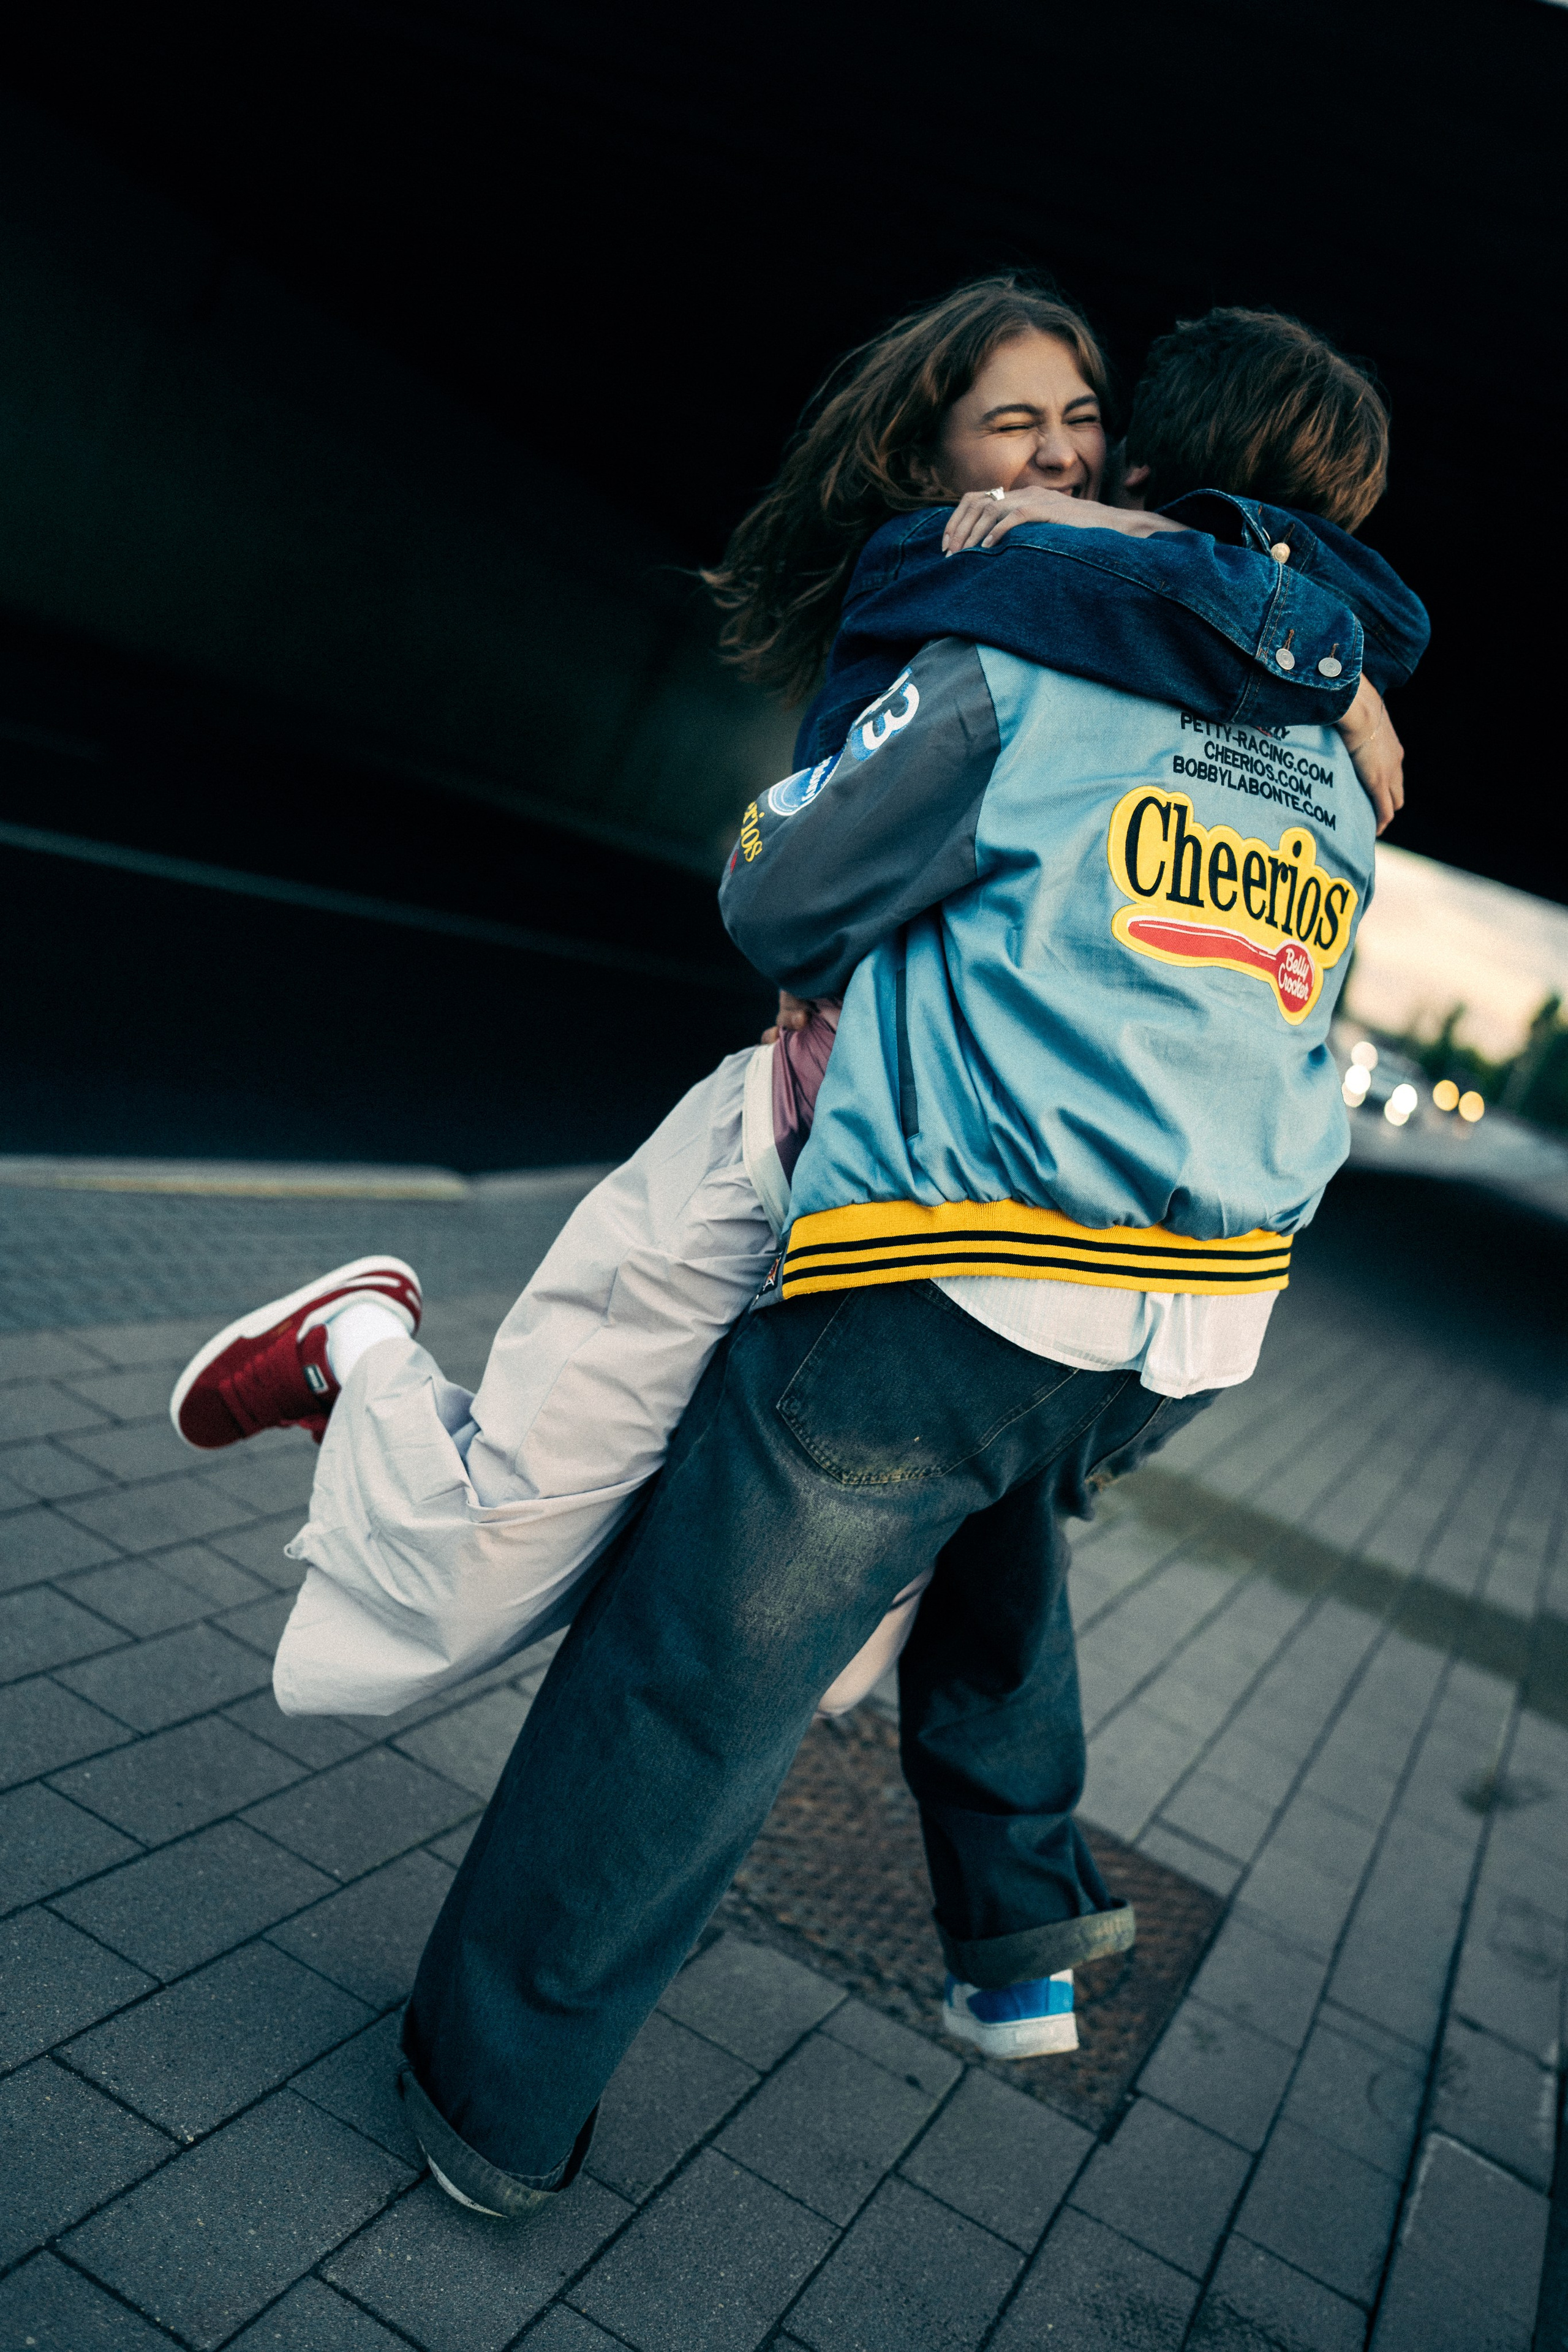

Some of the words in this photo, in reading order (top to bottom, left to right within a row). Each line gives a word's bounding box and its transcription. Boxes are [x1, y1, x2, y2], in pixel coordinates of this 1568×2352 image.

[854, 669, 920, 752] 3
[1180, 712, 1333, 788] PETTY-RACING.COM
[1204, 740, 1312, 799] CHEERIOS.COM
[1172, 755, 1336, 831] BOBBYLABONTE.COM
[1125, 796, 1350, 951] Cheerios
[1278, 962, 1309, 1001] Crocker
